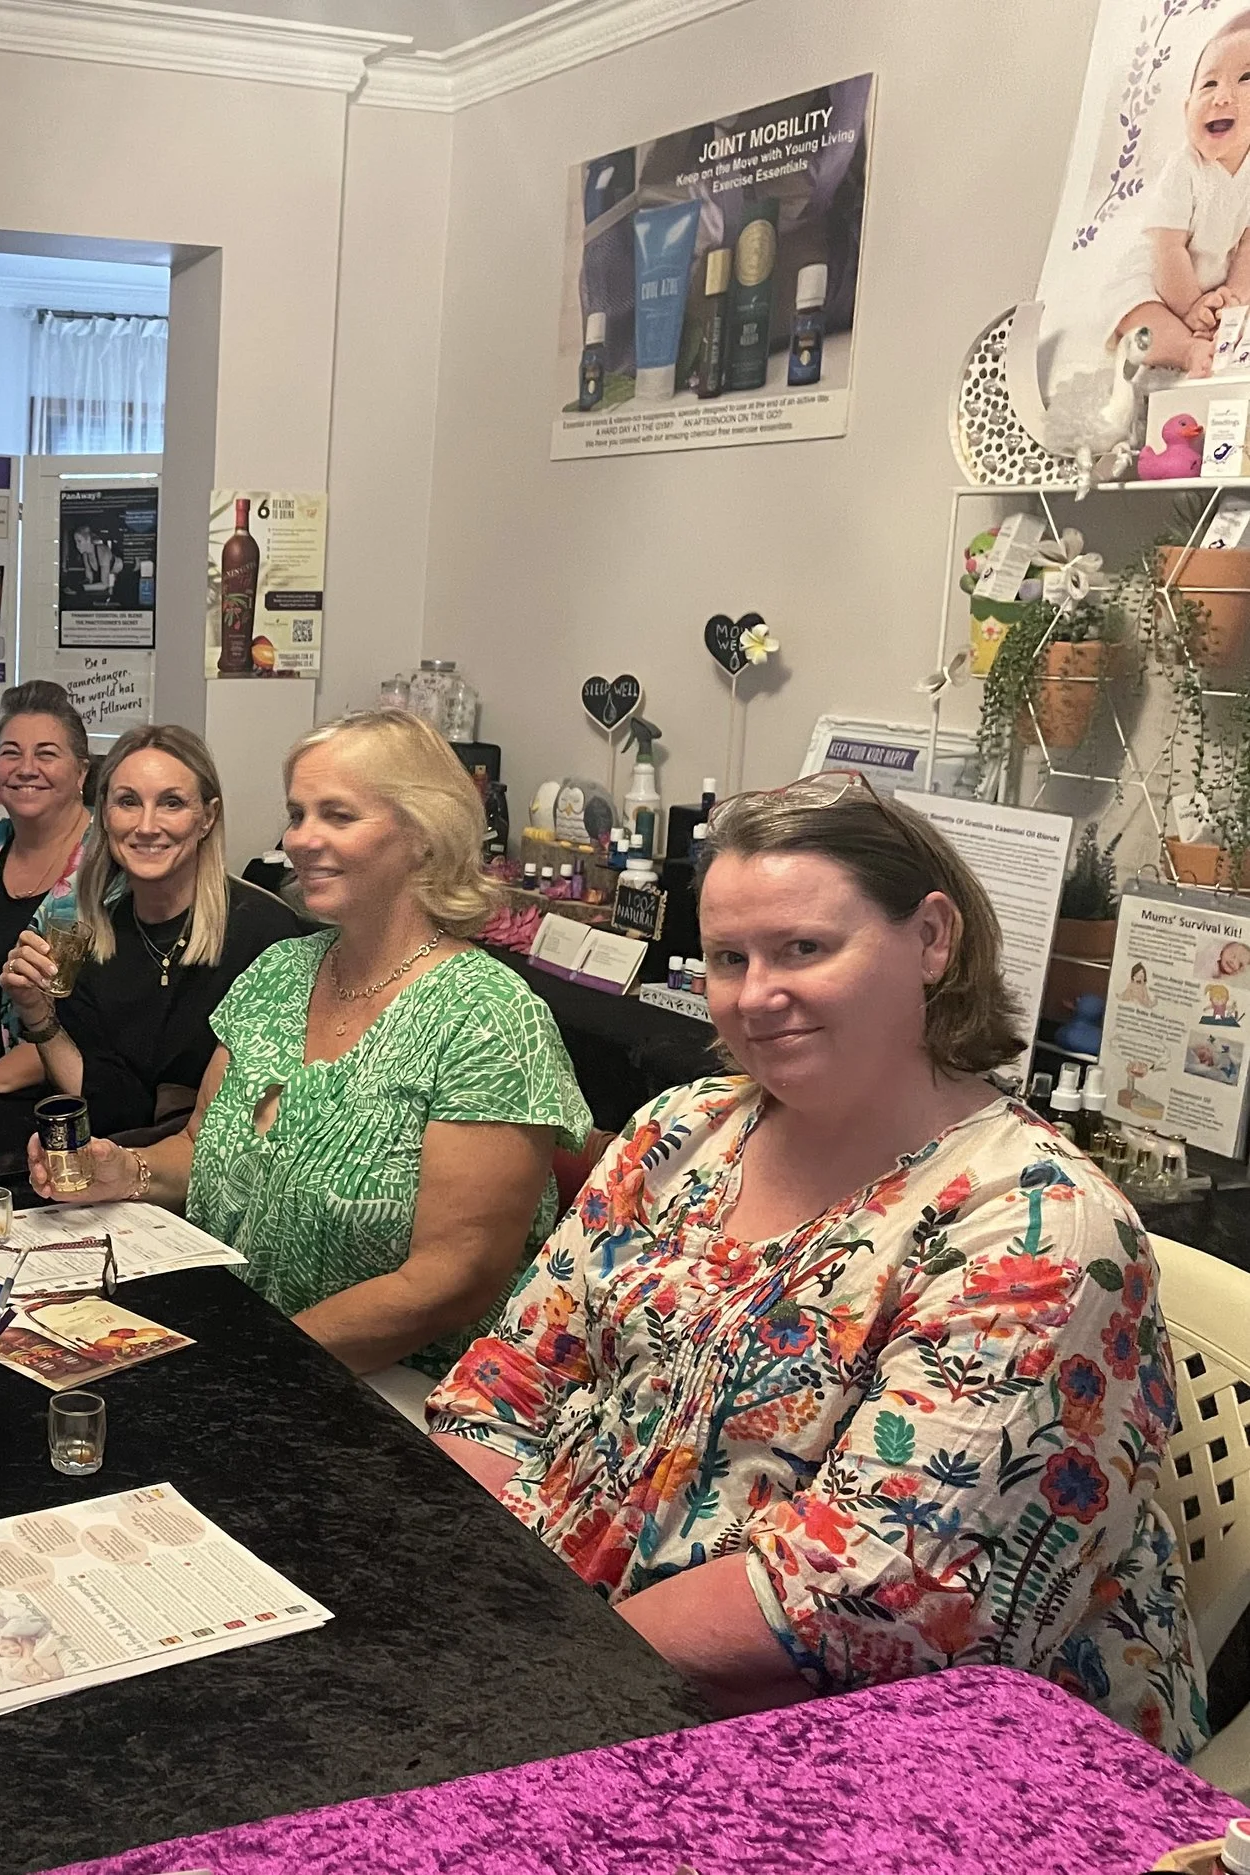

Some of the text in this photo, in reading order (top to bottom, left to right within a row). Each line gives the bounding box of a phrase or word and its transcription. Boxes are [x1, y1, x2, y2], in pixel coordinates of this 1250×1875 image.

[699, 106, 833, 163] JOINT MOBILITY
[676, 128, 855, 186] Keep on the Move with Young Living
[712, 158, 808, 193] Exercise Essentials
[642, 422, 654, 431] THE
[257, 499, 270, 519] 6
[272, 500, 295, 509] REASONS
[272, 510, 278, 519] TO
[84, 657, 98, 669] Be
[68, 683, 135, 705] The world has
[585, 681, 638, 697] SLEEP WELL
[99, 698, 142, 723] followers
[830, 743, 910, 767] KEEP YOUR KIDS HAPPY
[995, 824, 1025, 836] Essential
[1026, 829, 1036, 838] Oil
[1037, 832, 1060, 843] Blends
[628, 891, 656, 911] 100%
[617, 904, 654, 928] NATURAL
[1141, 910, 1243, 938] Mums' Survival Kit!
